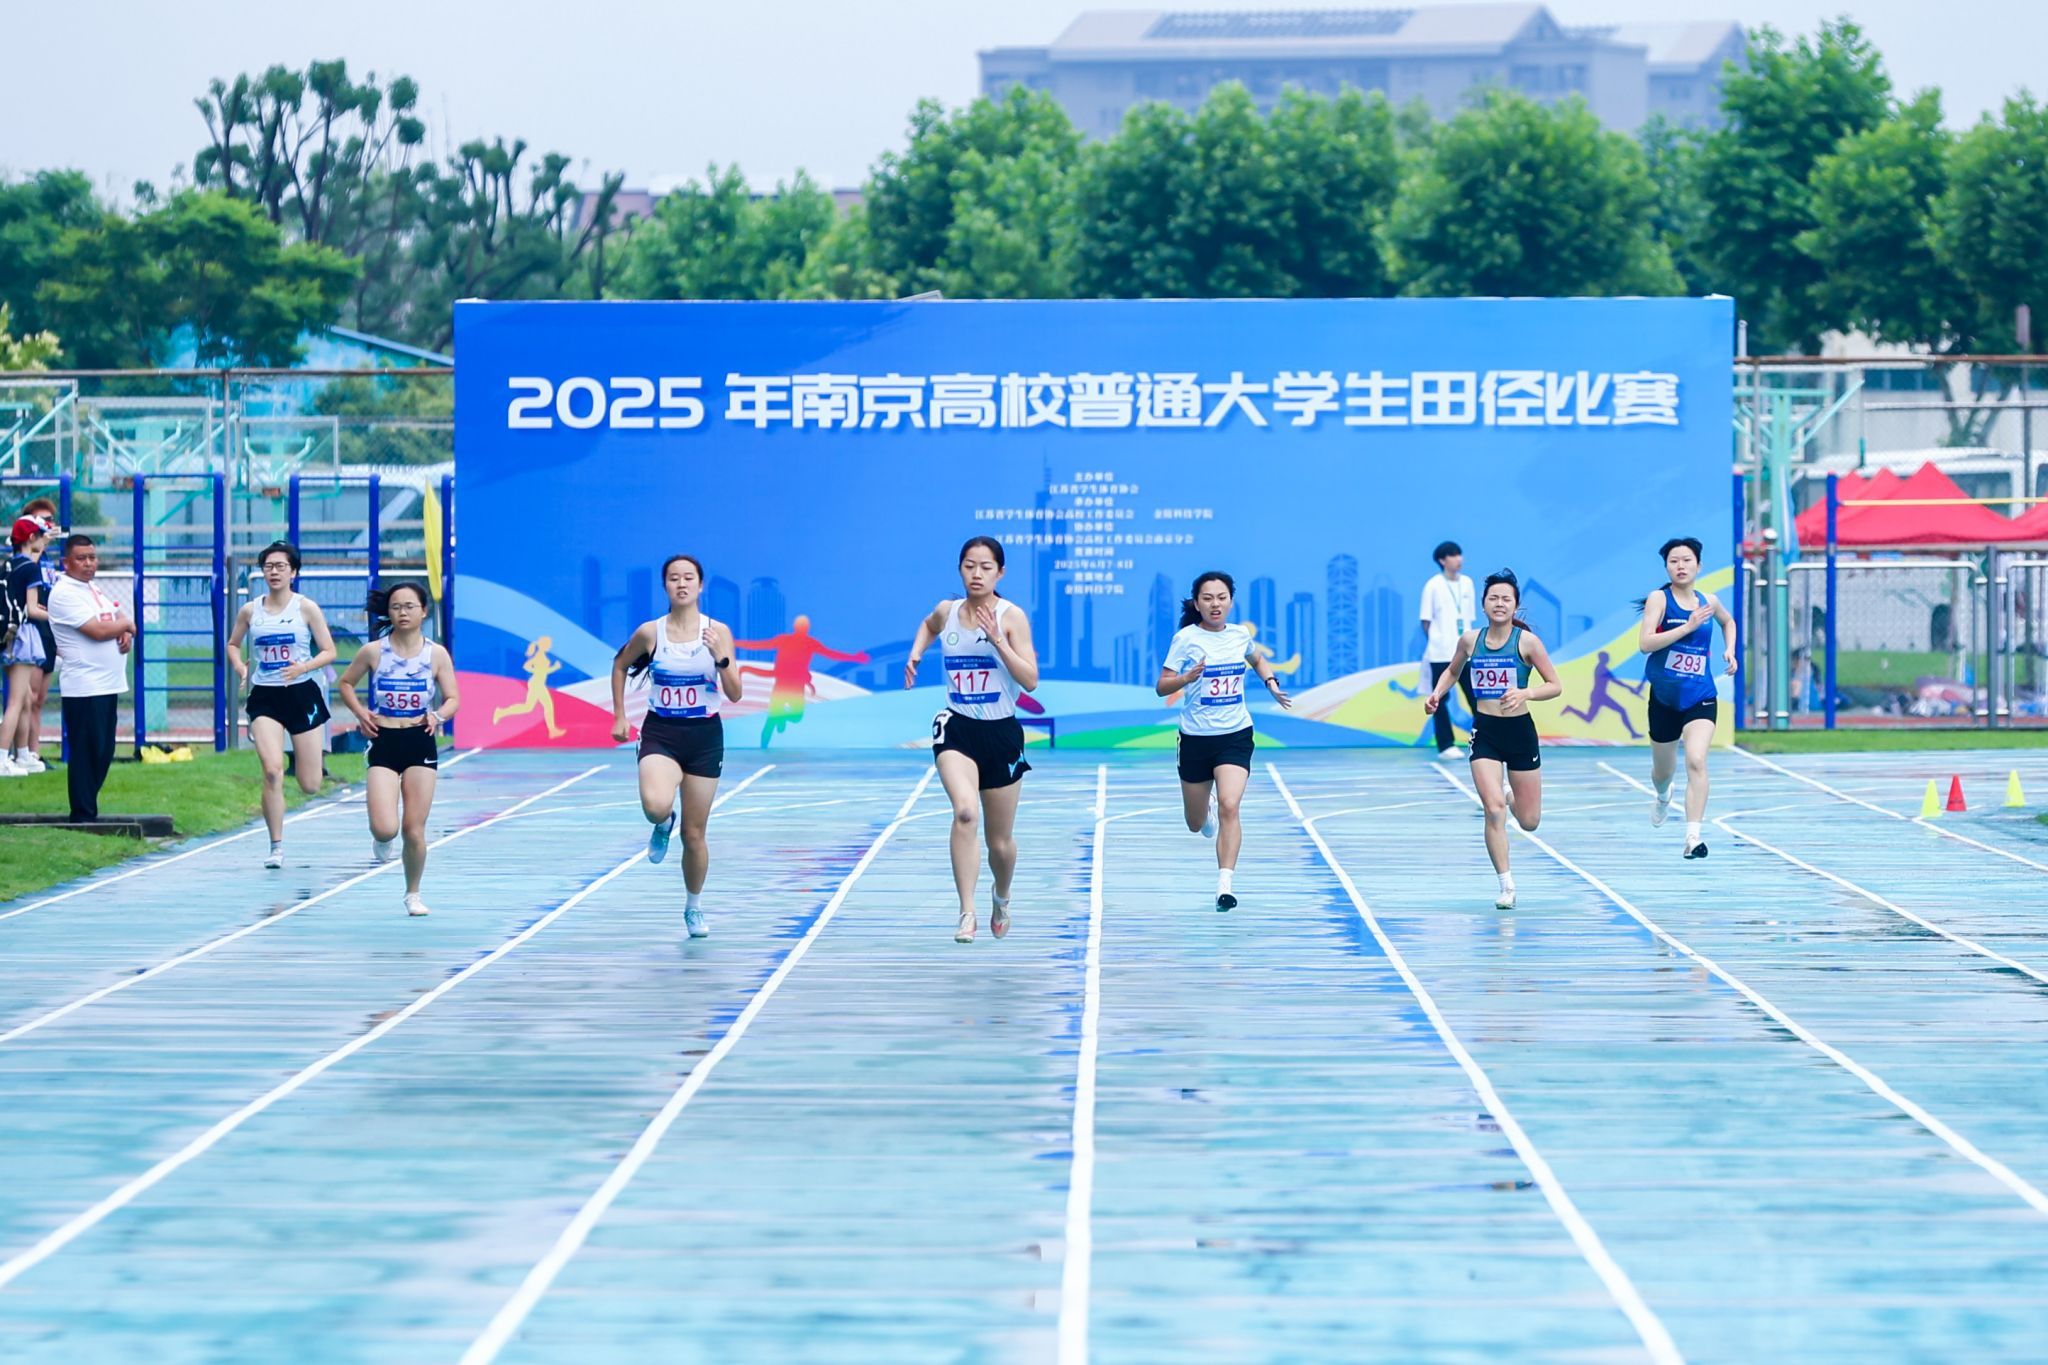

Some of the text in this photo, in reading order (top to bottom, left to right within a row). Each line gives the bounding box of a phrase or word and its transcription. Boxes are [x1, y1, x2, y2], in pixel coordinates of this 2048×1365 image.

[508, 371, 1680, 428] 2025 年南京高校普通大学生田径比赛
[1074, 472, 1114, 482] 主办单位
[263, 645, 291, 662] 116
[1671, 653, 1702, 673] 293
[953, 670, 990, 694] 117
[1209, 676, 1240, 697] 312
[1475, 669, 1509, 688] 294
[384, 692, 421, 710] 358
[660, 687, 697, 707] 010
